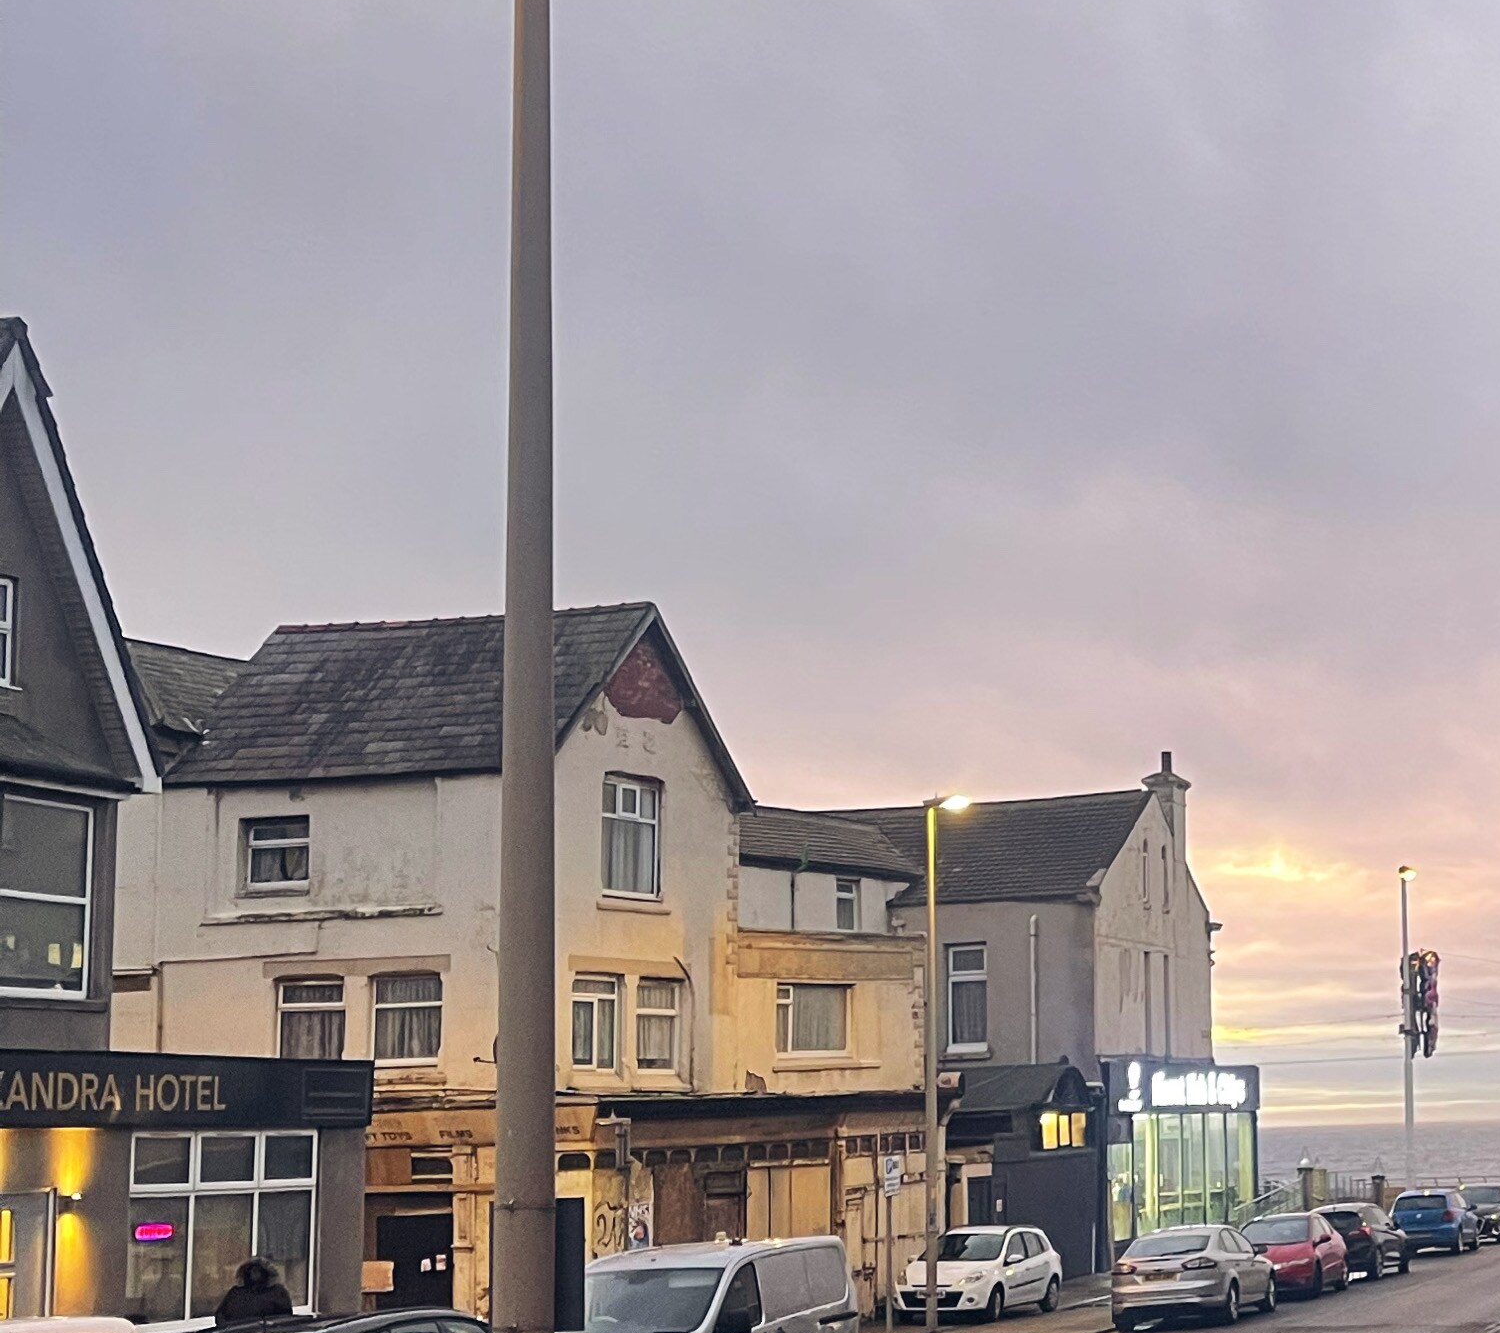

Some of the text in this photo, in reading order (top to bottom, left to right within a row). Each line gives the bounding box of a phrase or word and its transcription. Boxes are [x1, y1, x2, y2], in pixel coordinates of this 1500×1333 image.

[135, 1074, 227, 1111] HOTEL
[381, 1132, 413, 1140] TOYS
[439, 1130, 473, 1138] FILMS
